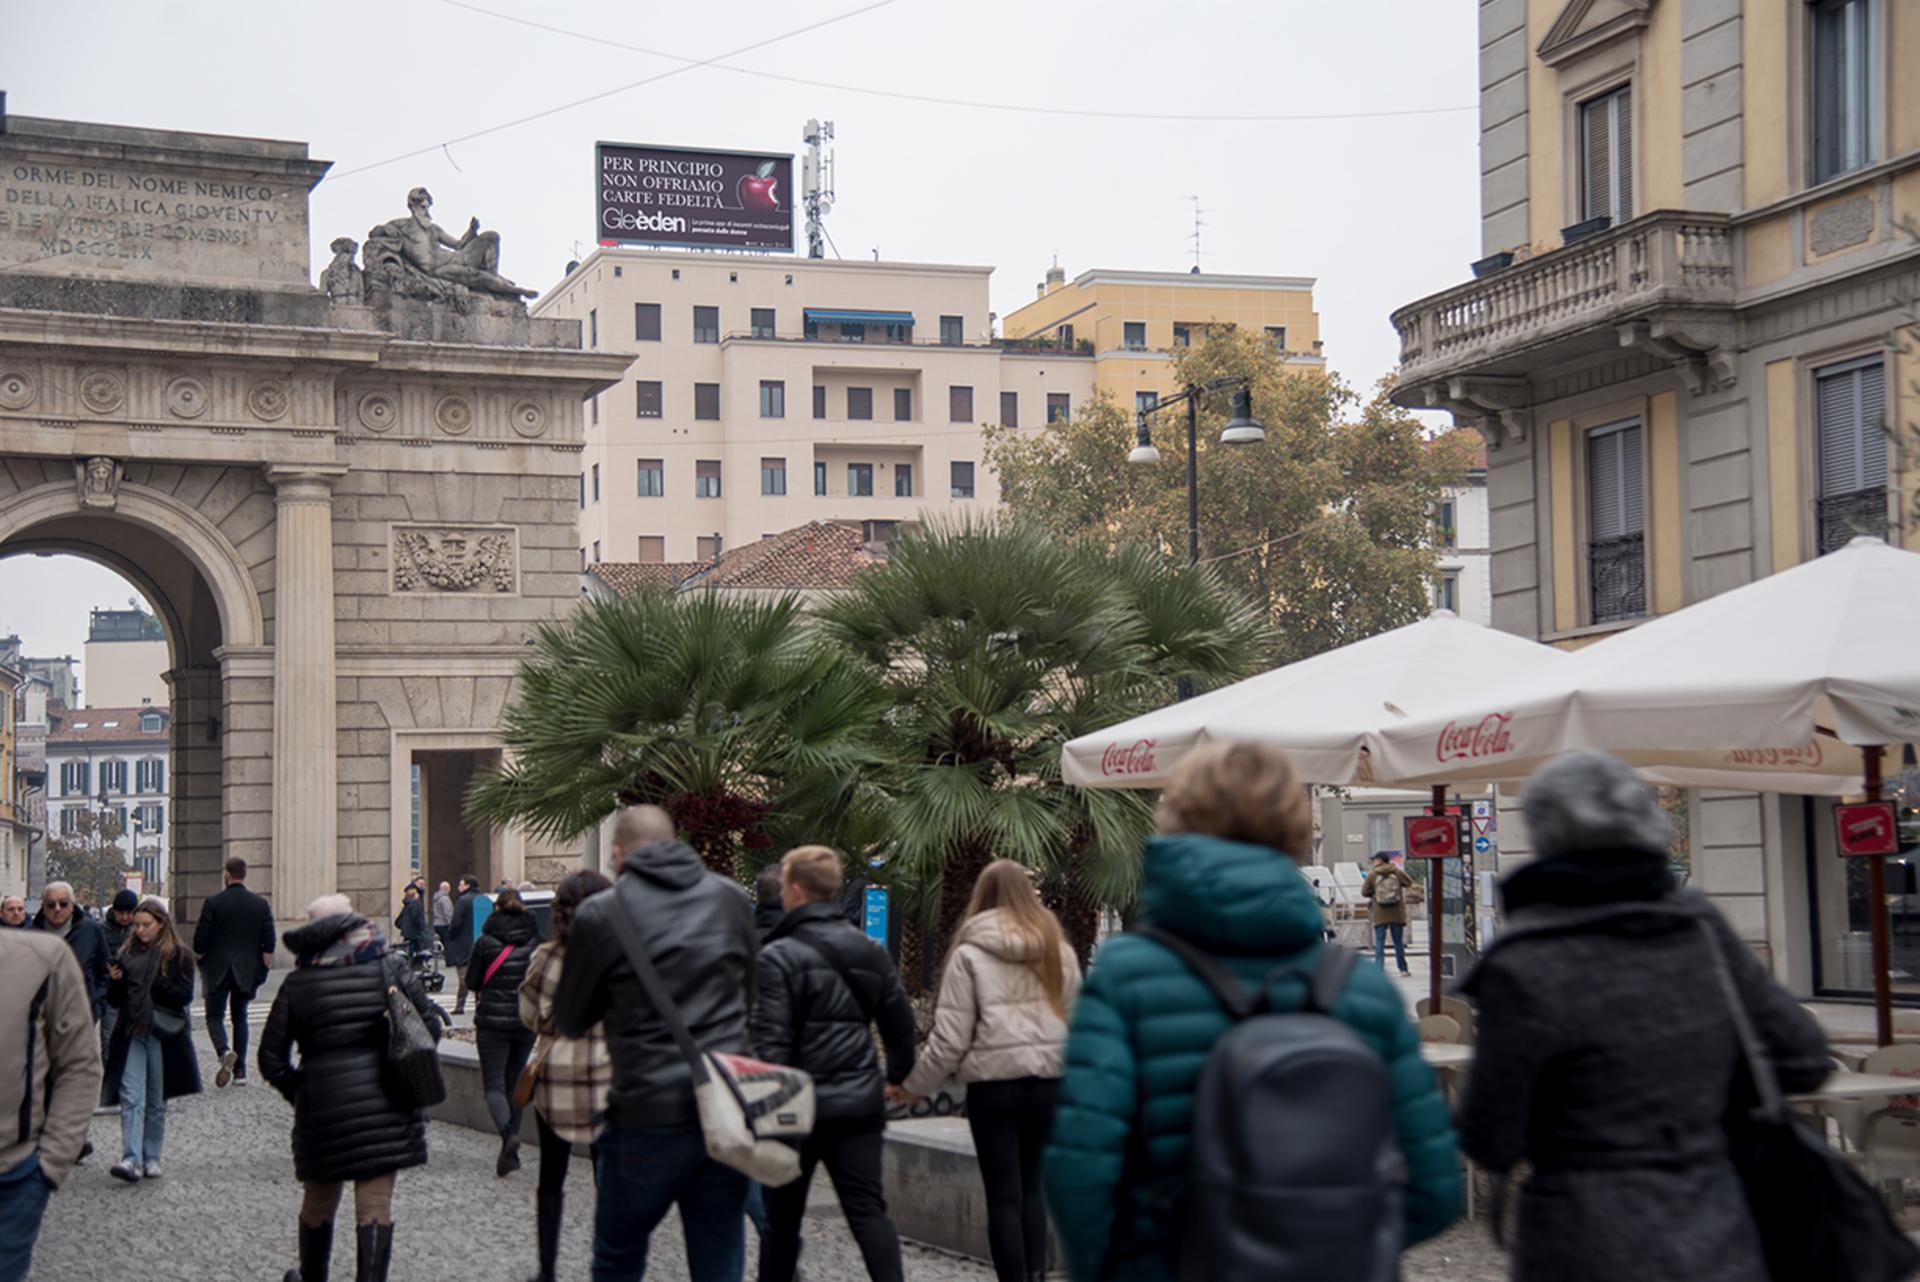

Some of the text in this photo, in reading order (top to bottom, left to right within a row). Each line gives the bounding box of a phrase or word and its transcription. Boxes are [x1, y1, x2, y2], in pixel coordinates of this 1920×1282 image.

[603, 156, 723, 177] PER PRINCIPIO
[13, 166, 272, 201] ORME DEL NOME NEMICO
[603, 173, 724, 193] NON OFFRIAMO
[6, 188, 76, 209] DELLA
[86, 195, 168, 216] ITALICA
[603, 189, 724, 209] CARTE FEDELTÀ
